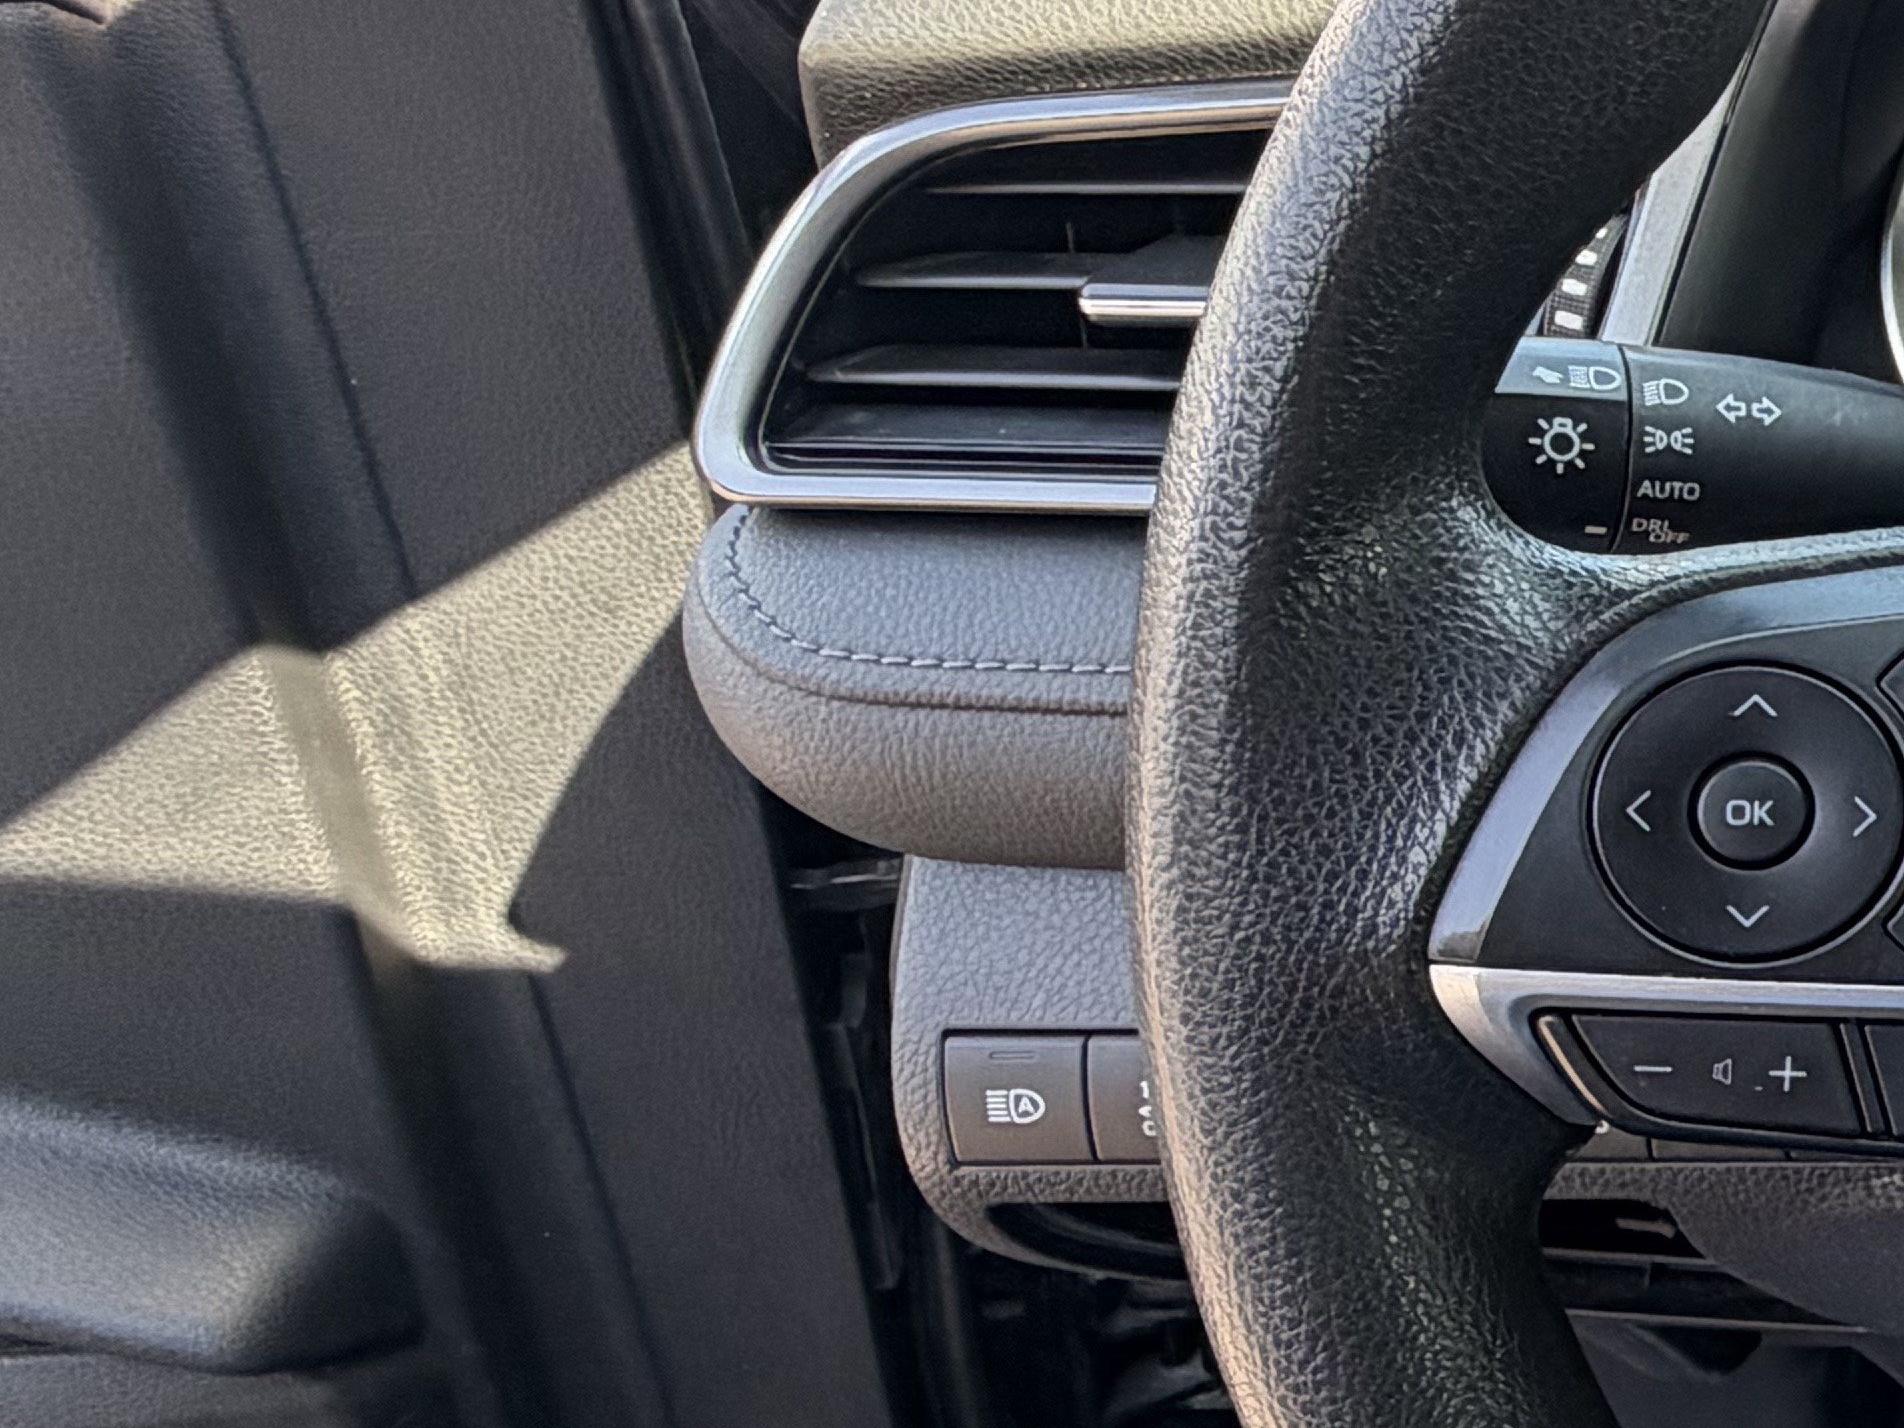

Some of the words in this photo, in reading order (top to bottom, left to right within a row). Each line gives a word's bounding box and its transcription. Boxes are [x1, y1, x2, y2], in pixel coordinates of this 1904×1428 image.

[1637, 480, 1700, 500] AUTO
[1631, 517, 1672, 532] DRL
[1726, 800, 1773, 825] OK
